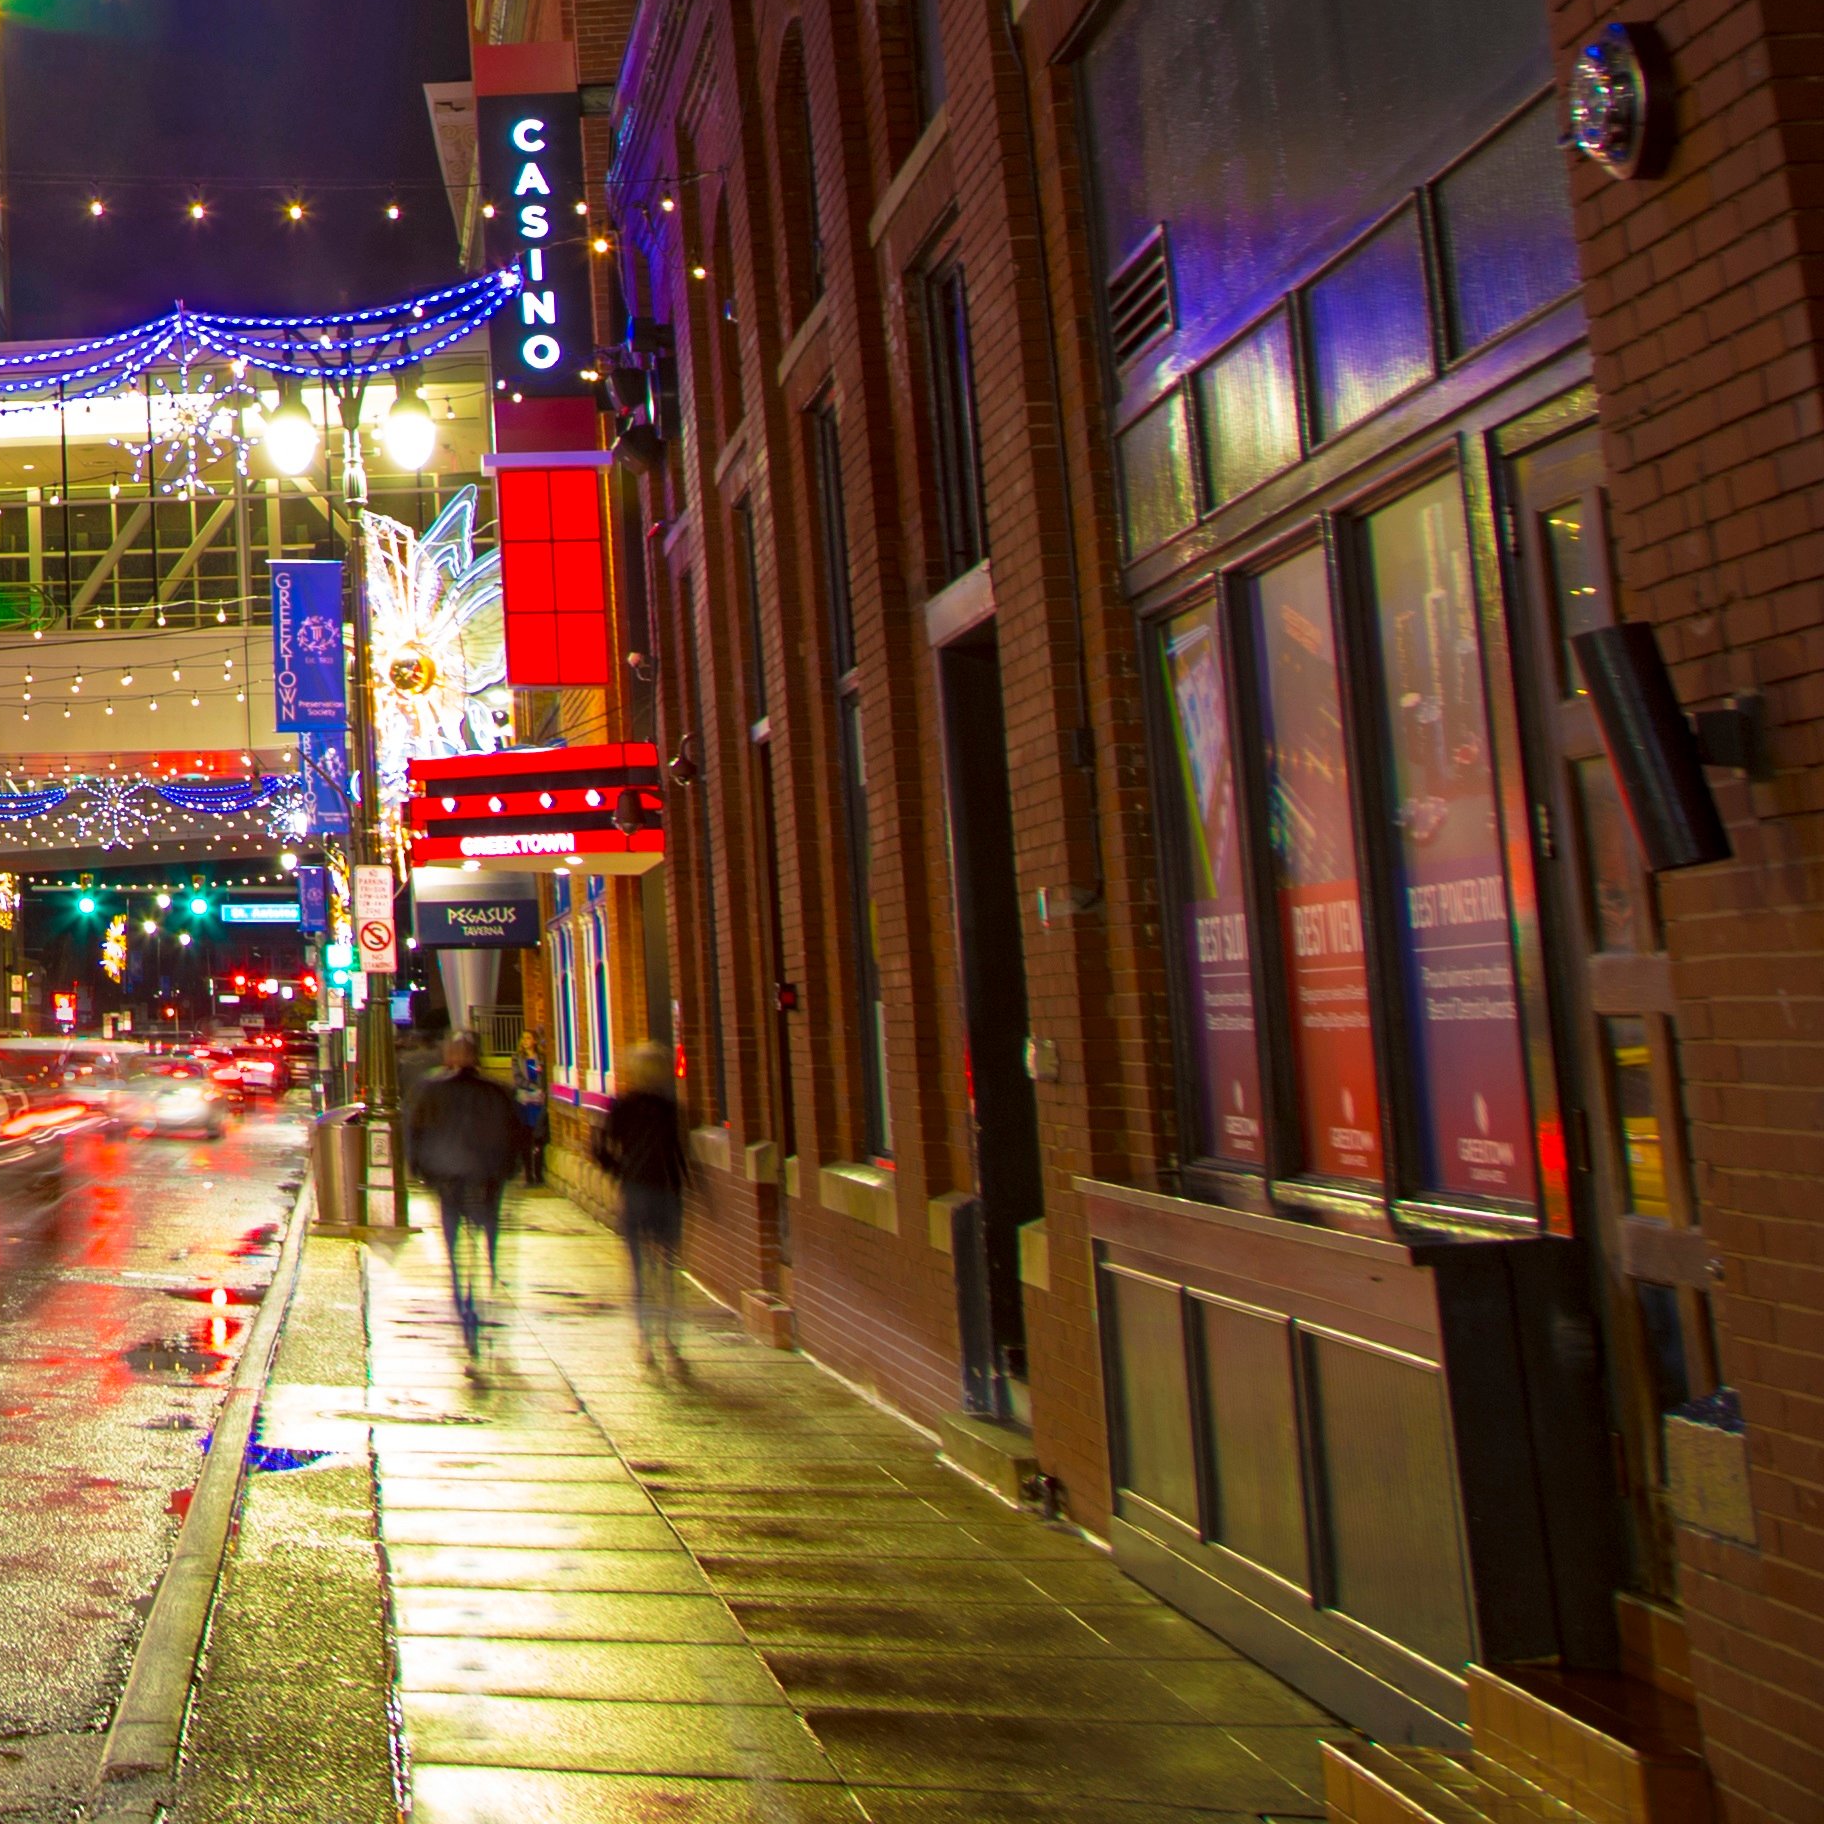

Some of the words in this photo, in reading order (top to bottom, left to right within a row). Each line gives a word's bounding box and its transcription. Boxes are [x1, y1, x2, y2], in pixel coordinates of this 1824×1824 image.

[512, 118, 561, 370] CASINO
[275, 572, 297, 721] GREEKTOWN
[460, 832, 575, 856] GREEKTOWN
[447, 907, 517, 925] PEGASUS
[462, 925, 505, 937] TAVERNA
[1195, 916, 1223, 962] BEST
[1292, 903, 1327, 956] BEST
